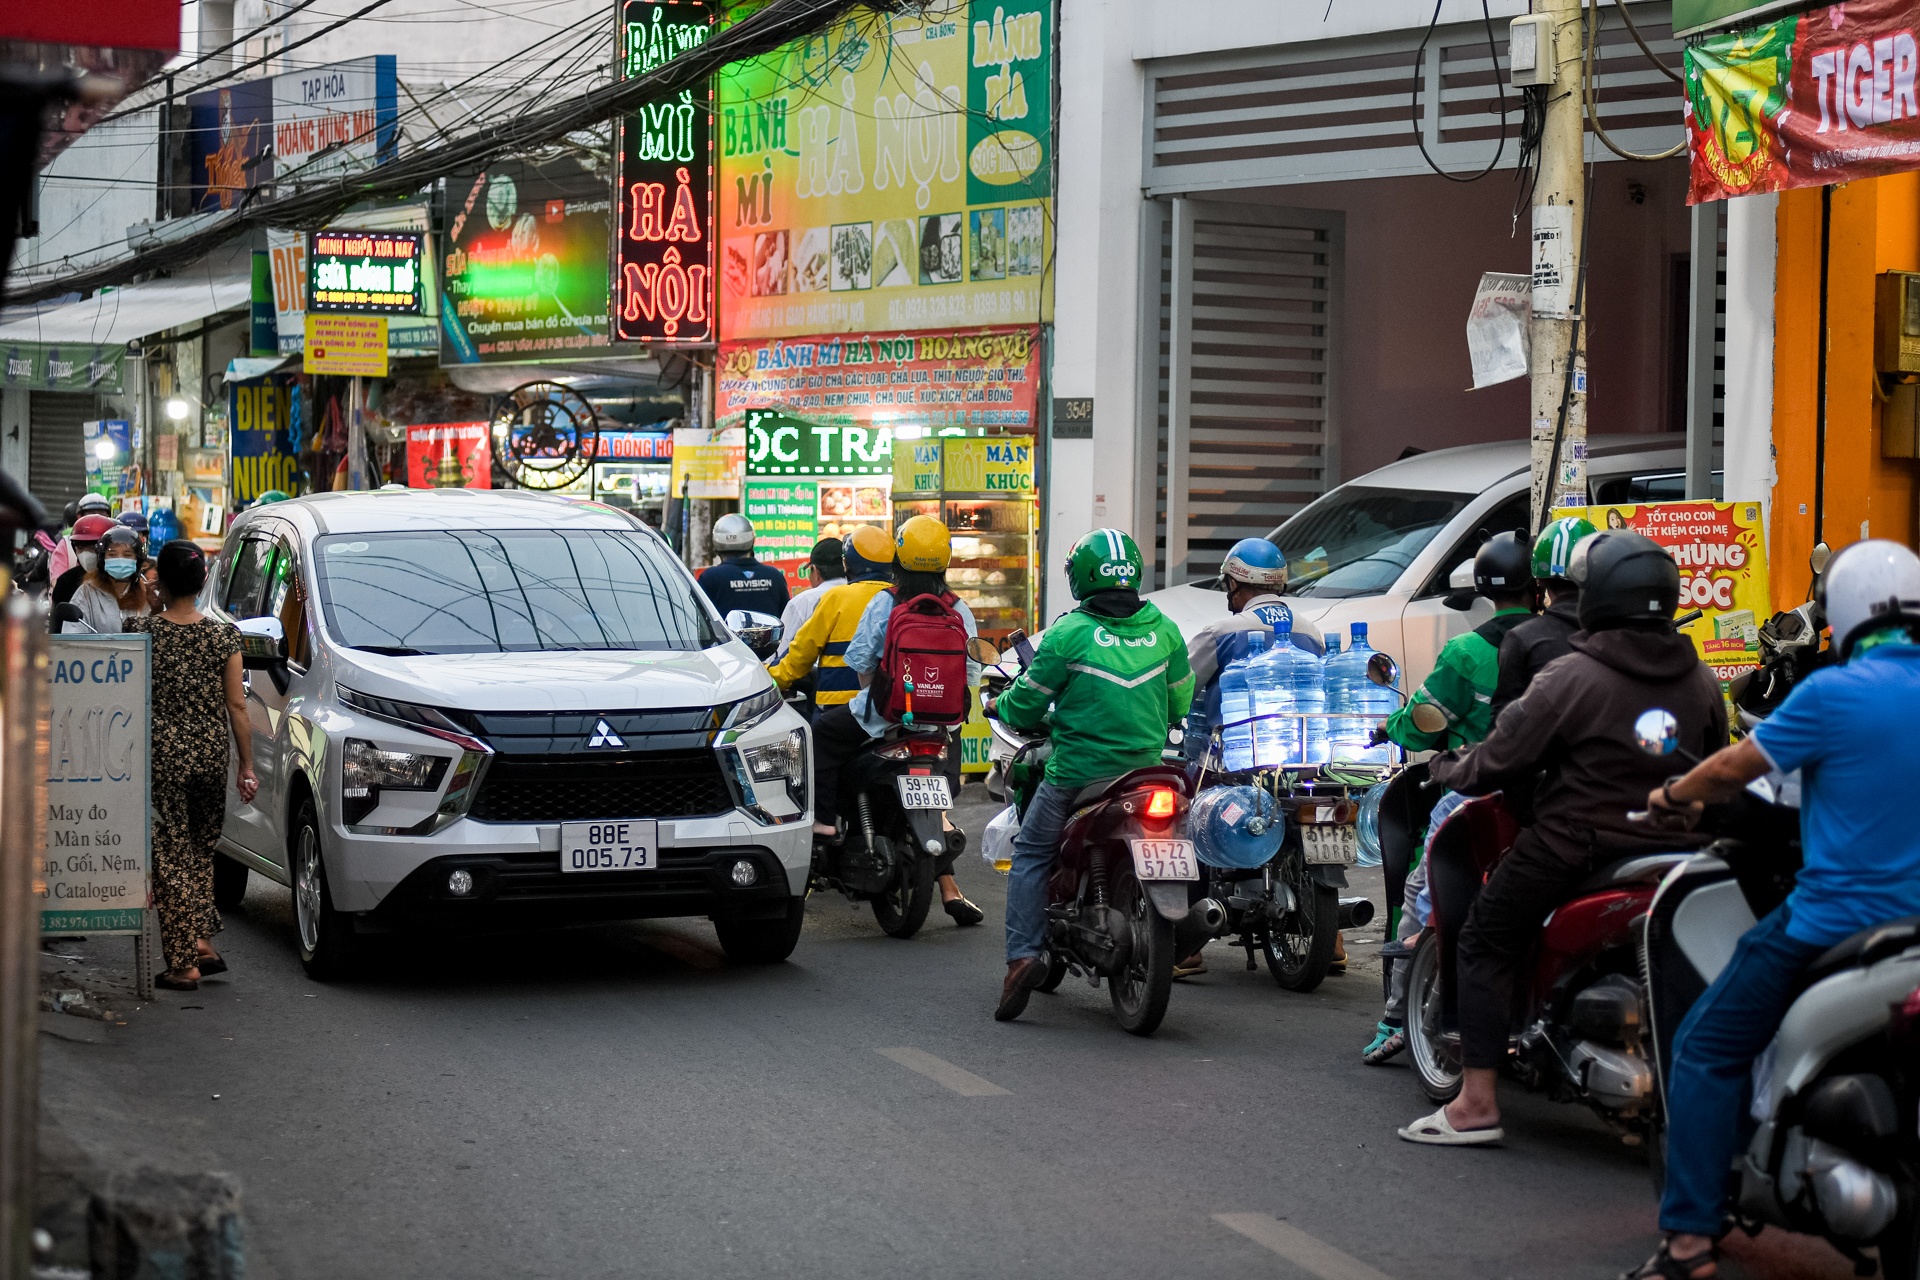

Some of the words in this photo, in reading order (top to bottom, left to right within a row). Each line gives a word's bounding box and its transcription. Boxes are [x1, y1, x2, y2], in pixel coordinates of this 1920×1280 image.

[973, 5, 1042, 68] BÁNH
[324, 68, 346, 98] HÓA
[1811, 32, 1918, 135] TIGER
[724, 91, 788, 157] BÁNH
[796, 75, 864, 199] HÀ
[873, 60, 962, 210] NỘI
[735, 156, 773, 227] MÌ
[629, 167, 702, 243] HÀ
[318, 238, 343, 255] MINH
[374, 239, 394, 257] XƯA
[395, 241, 414, 258] NAY
[623, 246, 707, 335] NỘI
[905, 297, 927, 319] 0924
[929, 295, 946, 318] 328
[949, 294, 966, 316] 823
[503, 320, 524, 331] mua
[724, 344, 751, 374] LÒ
[755, 341, 814, 371] BÁNH
[816, 337, 842, 367] MÌ
[844, 335, 873, 365] HÀ
[877, 333, 915, 368] NỘI
[918, 332, 994, 361] HOÀNG
[8, 358, 32, 377] TUBORG
[48, 359, 73, 378] TUBORG
[761, 378, 786, 392] CUNG
[788, 374, 806, 390] CẤP
[845, 370, 862, 386] CÁC
[235, 378, 291, 441] ĐIỆN
[824, 392, 845, 406] NEM
[846, 391, 872, 406] CHUA,
[614, 431, 653, 458] ĐỒNG
[985, 440, 1029, 466] MẶN
[233, 452, 298, 501] NƯỚC
[914, 470, 940, 490] KHÚC
[985, 469, 1030, 490] KHÚC
[748, 488, 766, 500] Bánh
[1647, 508, 1668, 523] TỐT
[1669, 511, 1692, 522] CHO
[1694, 511, 1716, 521] CON
[1637, 521, 1660, 537] TIẾT
[1661, 523, 1687, 537] KIỆM
[1688, 525, 1711, 535] CHO
[1712, 524, 1728, 537] MẸ
[754, 536, 784, 547] amburger
[1669, 538, 1745, 567] THÙNG
[1100, 562, 1135, 576] Grab
[730, 579, 772, 588] KBVISION
[1678, 566, 1733, 605] SỐC
[91, 652, 134, 684] CẤP
[906, 778, 942, 791] 59-H2
[906, 792, 949, 807] 098.86
[50, 804, 84, 825] May
[88, 804, 107, 820] đo
[55, 831, 91, 849] Màn
[95, 829, 121, 847] sáo
[589, 824, 630, 845] 88E
[572, 846, 647, 869] 005.73
[1142, 842, 1187, 860] 61-Z2
[67, 853, 98, 873] Gối,
[102, 855, 141, 875] Nệm,
[55, 881, 127, 903] Catalogue
[48, 917, 69, 930] 382
[71, 917, 89, 929] 976
